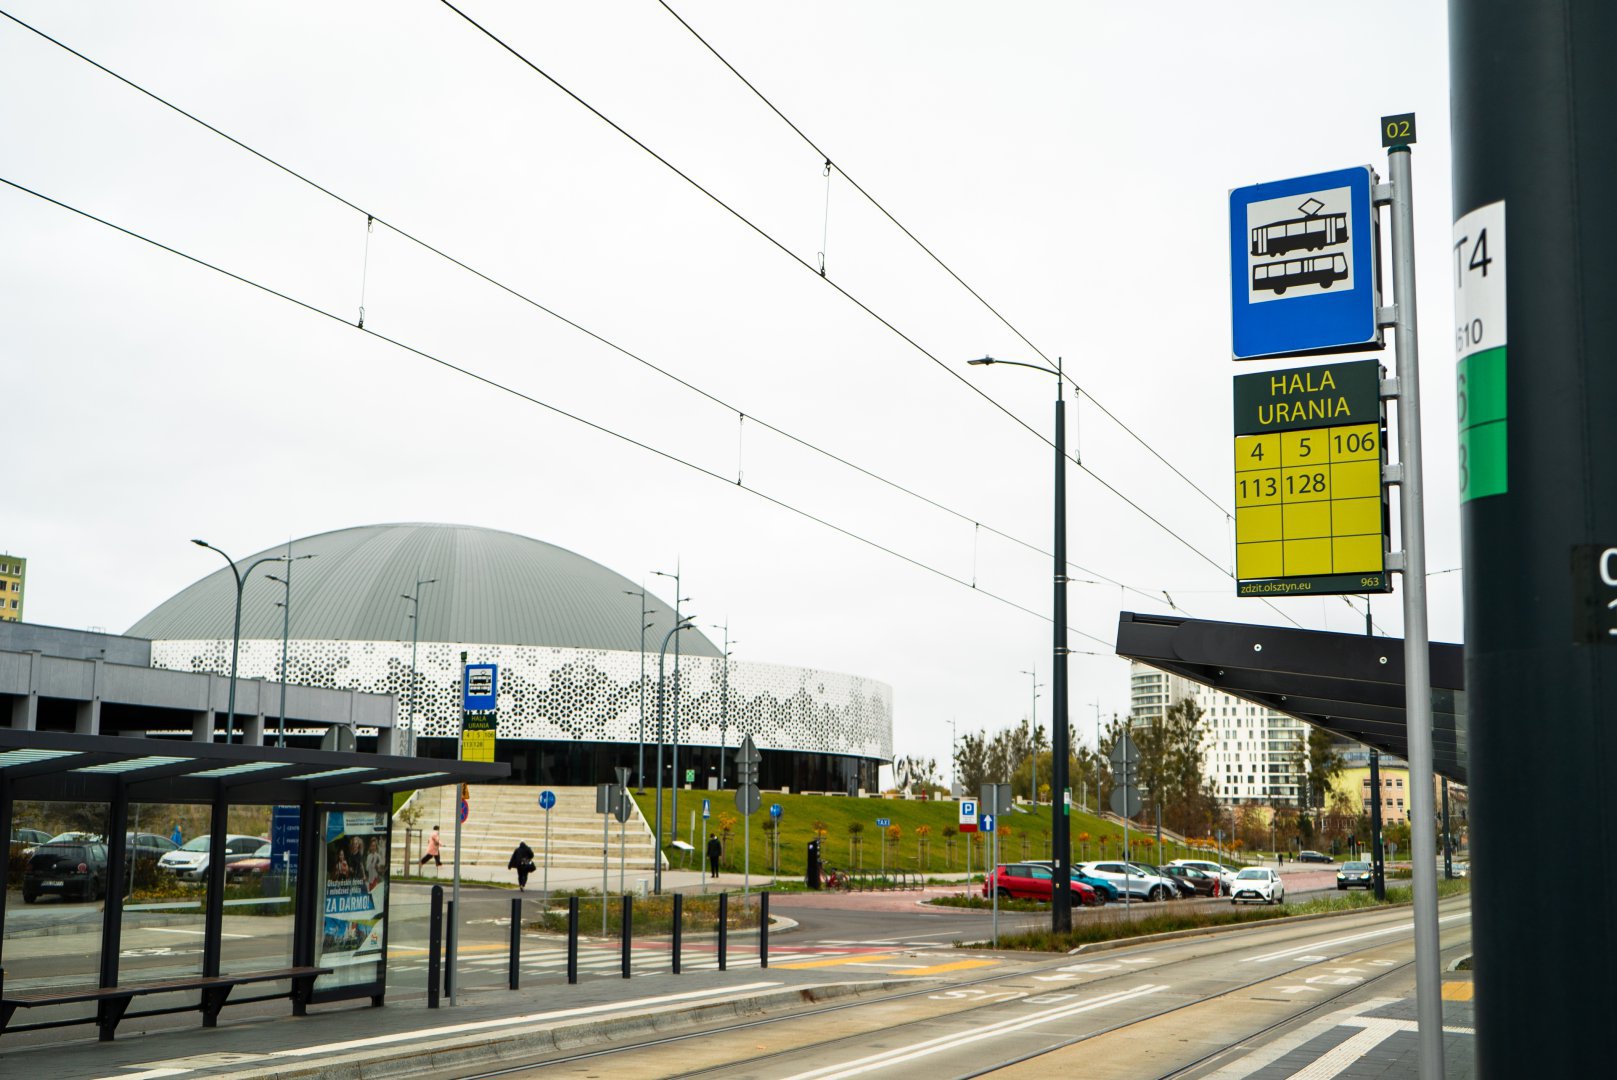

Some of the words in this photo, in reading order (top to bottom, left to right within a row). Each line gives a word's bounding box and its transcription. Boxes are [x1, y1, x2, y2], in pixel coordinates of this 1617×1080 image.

[1386, 120, 1411, 139] 02
[1271, 370, 1336, 396] HALA
[1258, 396, 1351, 425] URANIA
[1250, 442, 1265, 462] 4
[1299, 437, 1311, 458] 5
[1333, 431, 1375, 454] 106
[1240, 477, 1277, 499] 113
[1286, 472, 1326, 495] 128
[1240, 582, 1311, 594] zdzit.olsztyn.eu
[1360, 577, 1380, 587] 963
[326, 898, 337, 913] ZA
[339, 896, 370, 912] DARMO!
